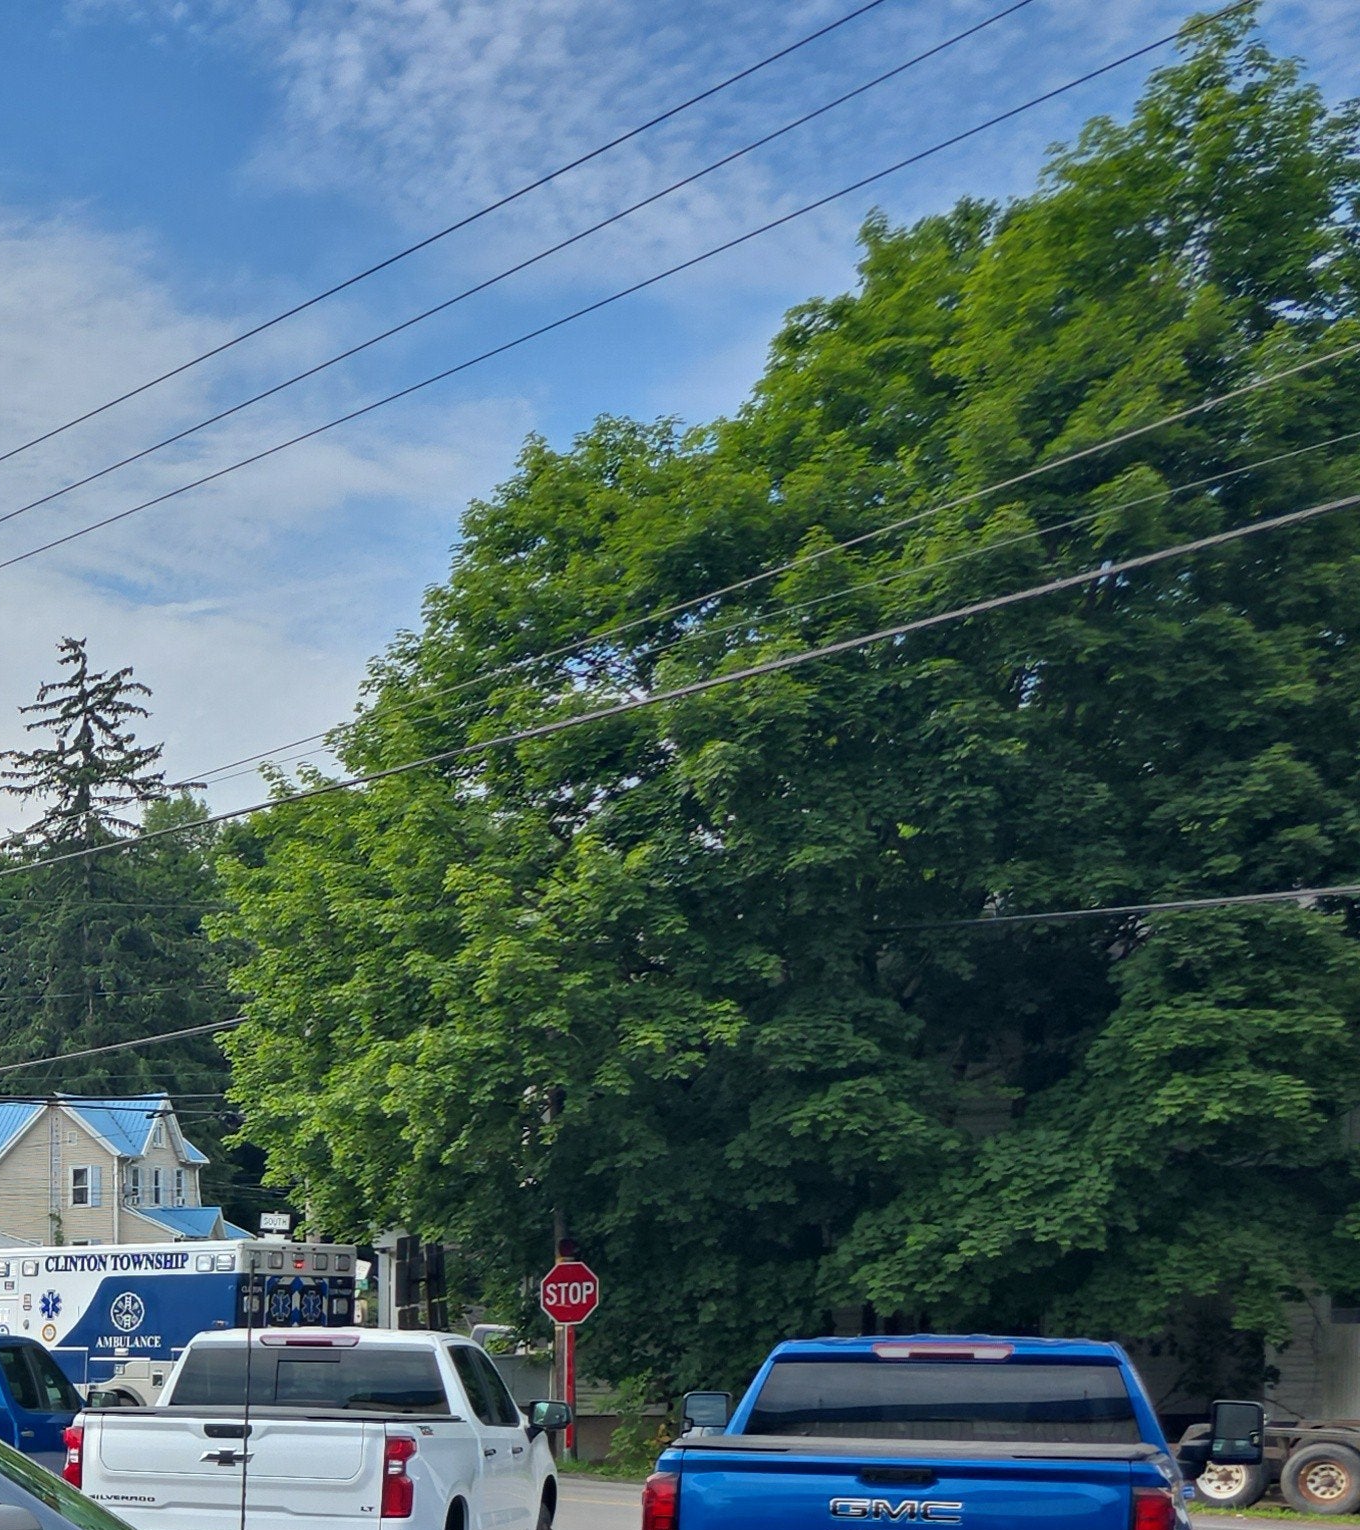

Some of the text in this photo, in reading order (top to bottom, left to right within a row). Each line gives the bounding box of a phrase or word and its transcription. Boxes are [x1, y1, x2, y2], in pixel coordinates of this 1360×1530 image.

[263, 1217, 287, 1226] SOUTH
[45, 1253, 189, 1272] CLINTON TOWNSHIP
[545, 1282, 594, 1305] STOP
[95, 1336, 161, 1348] AMBULANCE
[830, 1498, 963, 1524] GMC
